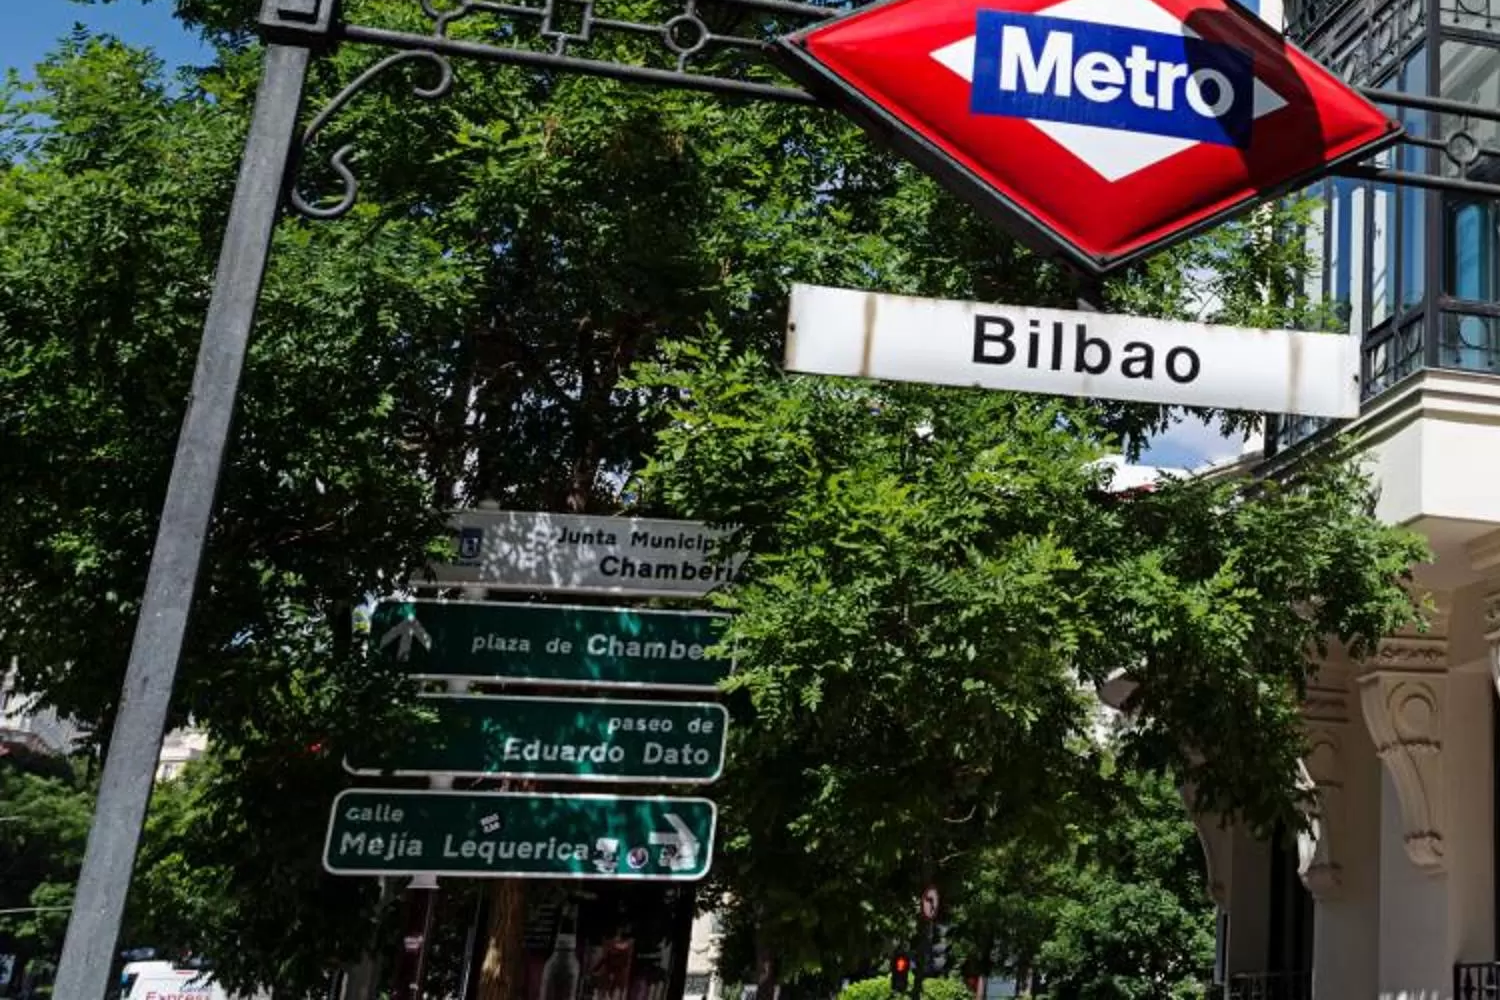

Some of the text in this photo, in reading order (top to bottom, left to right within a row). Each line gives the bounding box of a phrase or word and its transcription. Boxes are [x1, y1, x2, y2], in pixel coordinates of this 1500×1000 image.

[999, 24, 1235, 118] Metro
[971, 314, 1201, 385] Bilbao
[557, 528, 725, 553] Junta Municip
[472, 633, 531, 654] plaza
[545, 637, 573, 655] de
[608, 717, 714, 735] paseo de
[503, 737, 710, 765] Eduardo Dato
[345, 804, 405, 823] calle
[339, 831, 590, 865] Mejía Lequerica
